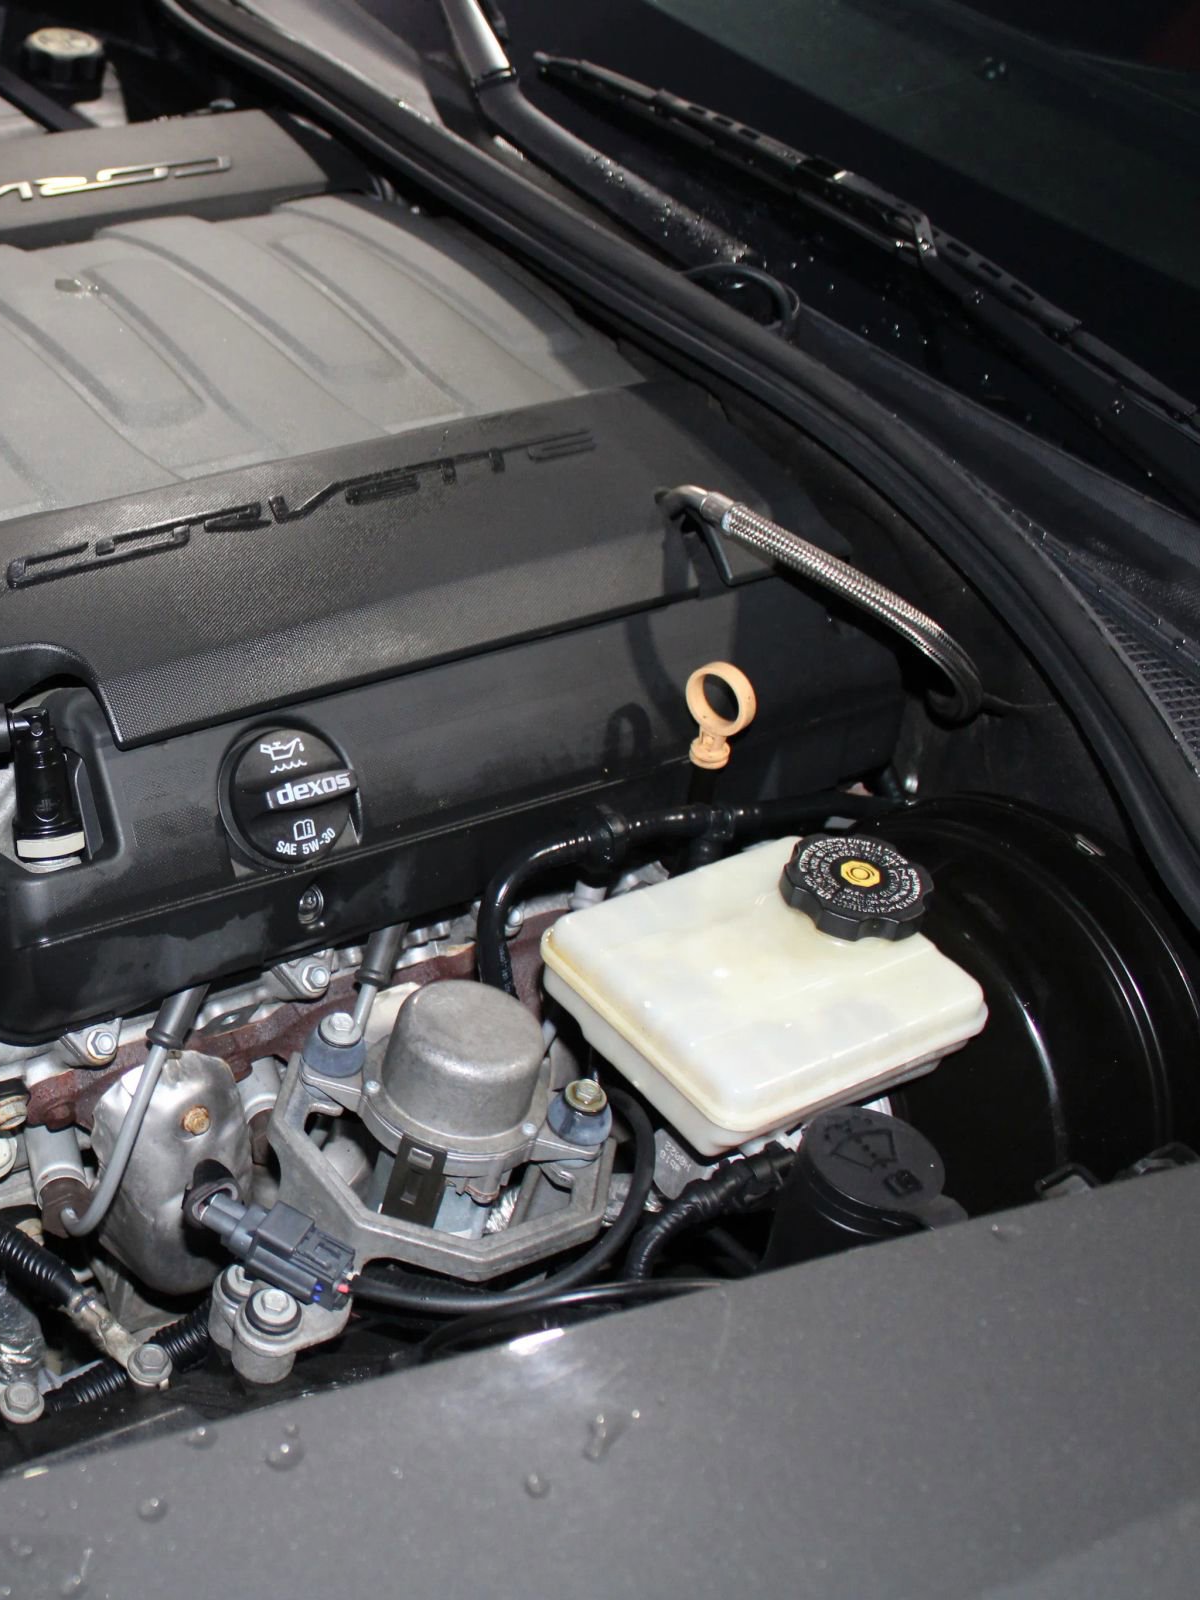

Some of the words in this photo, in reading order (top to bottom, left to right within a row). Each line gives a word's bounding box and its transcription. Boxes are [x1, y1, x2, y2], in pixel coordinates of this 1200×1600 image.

[6, 428, 597, 590] CORVETTE
[276, 772, 351, 805] dexos
[275, 840, 297, 856] SAE
[302, 827, 336, 855] 5W-30
